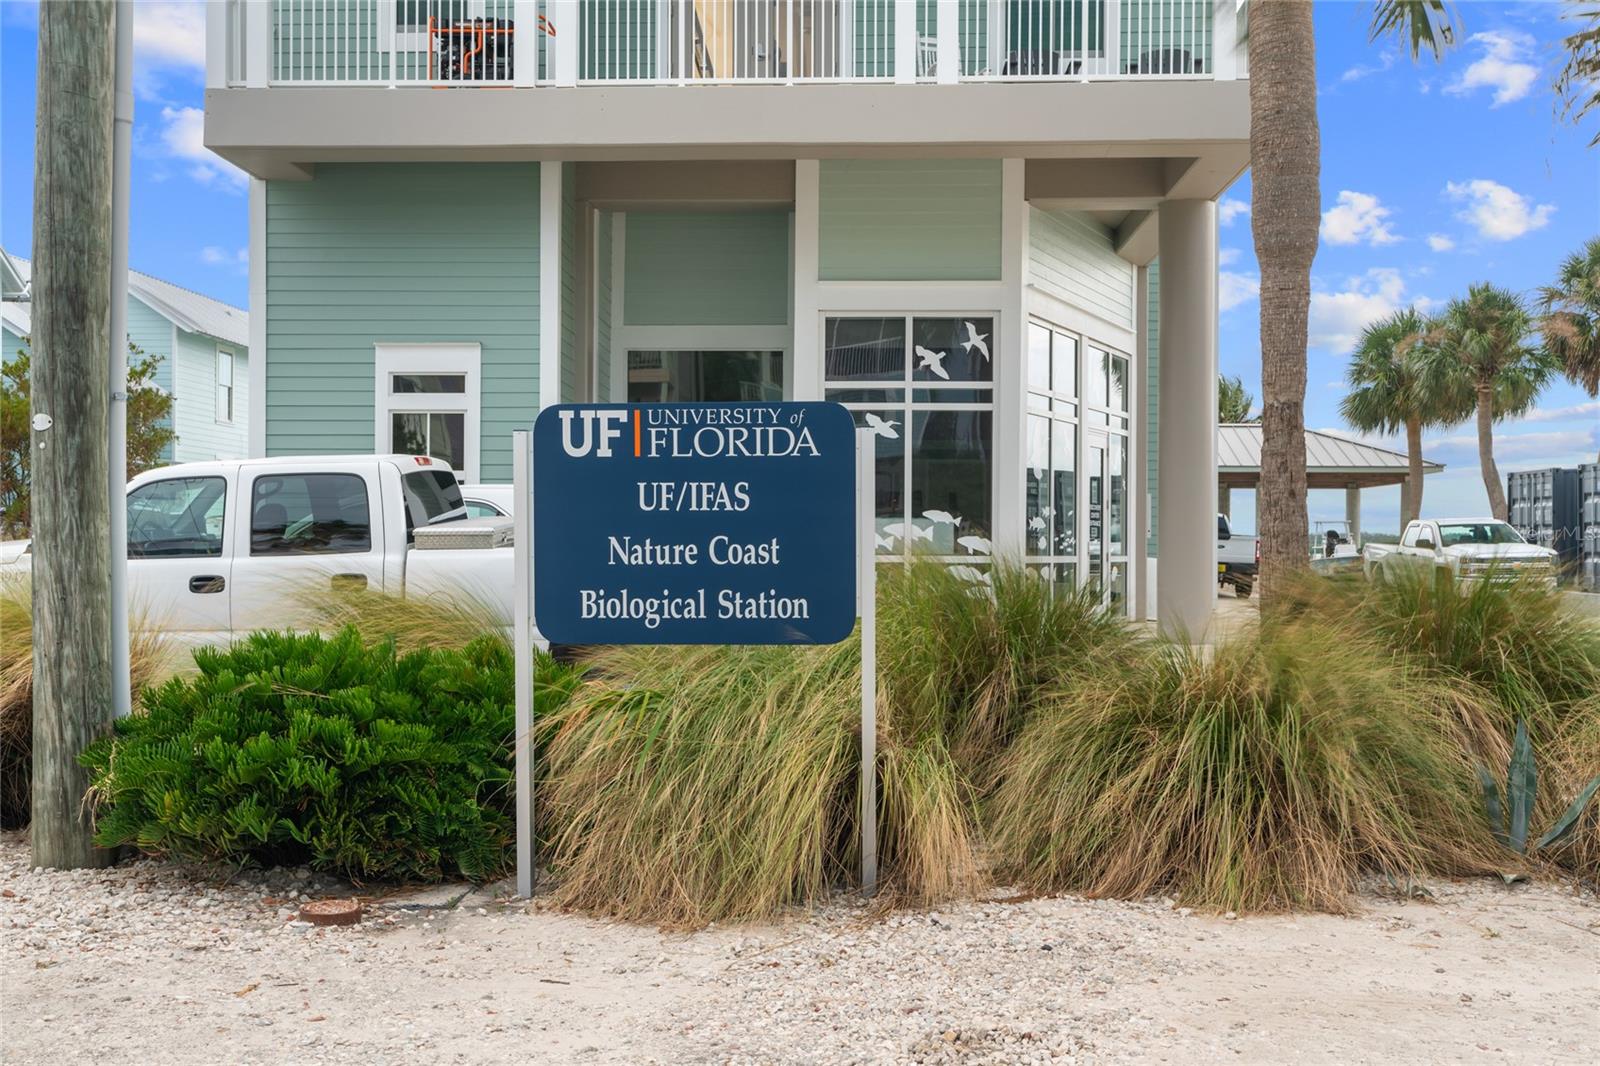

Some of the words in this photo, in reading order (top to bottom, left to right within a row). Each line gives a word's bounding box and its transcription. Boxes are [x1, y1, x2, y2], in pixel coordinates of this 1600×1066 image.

[647, 408, 781, 425] UNIVERSITY
[790, 408, 806, 426] of
[558, 410, 628, 458] UF
[647, 426, 822, 458] FLORIDA
[637, 481, 750, 512] UF/IFAS
[608, 536, 698, 566] Nature
[709, 535, 780, 565] Coast
[580, 588, 706, 628] Biological
[718, 588, 810, 619] Station
